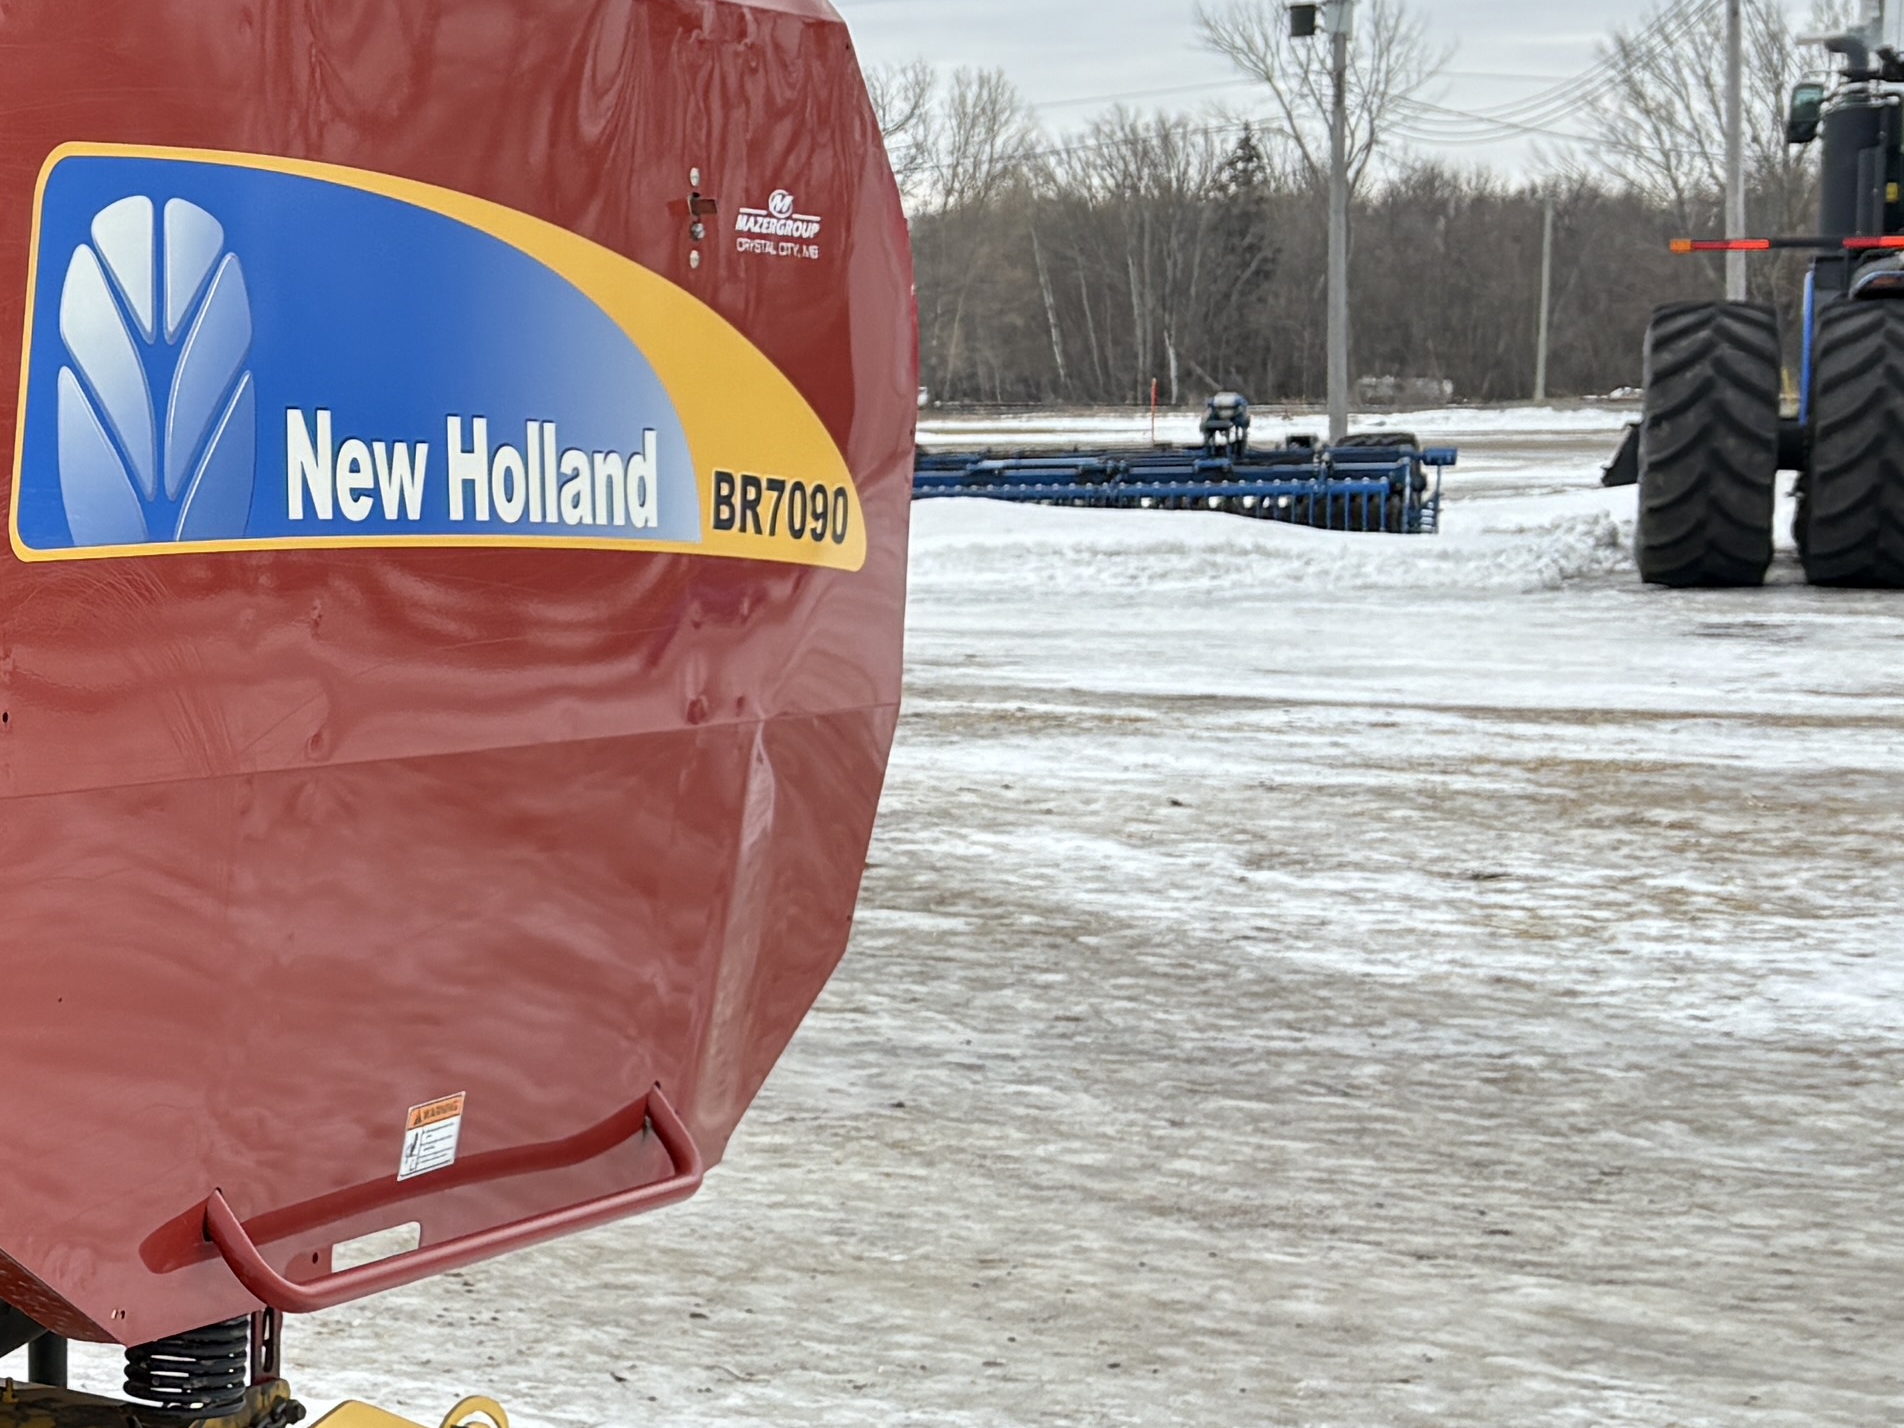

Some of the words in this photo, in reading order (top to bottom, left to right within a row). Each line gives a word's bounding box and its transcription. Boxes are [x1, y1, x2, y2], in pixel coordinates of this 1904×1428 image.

[735, 213, 821, 239] MAZERGROUP
[736, 237, 777, 255] CRYSTAL
[286, 408, 428, 522] New
[446, 413, 659, 529] Holland
[711, 469, 849, 547] BR7090
